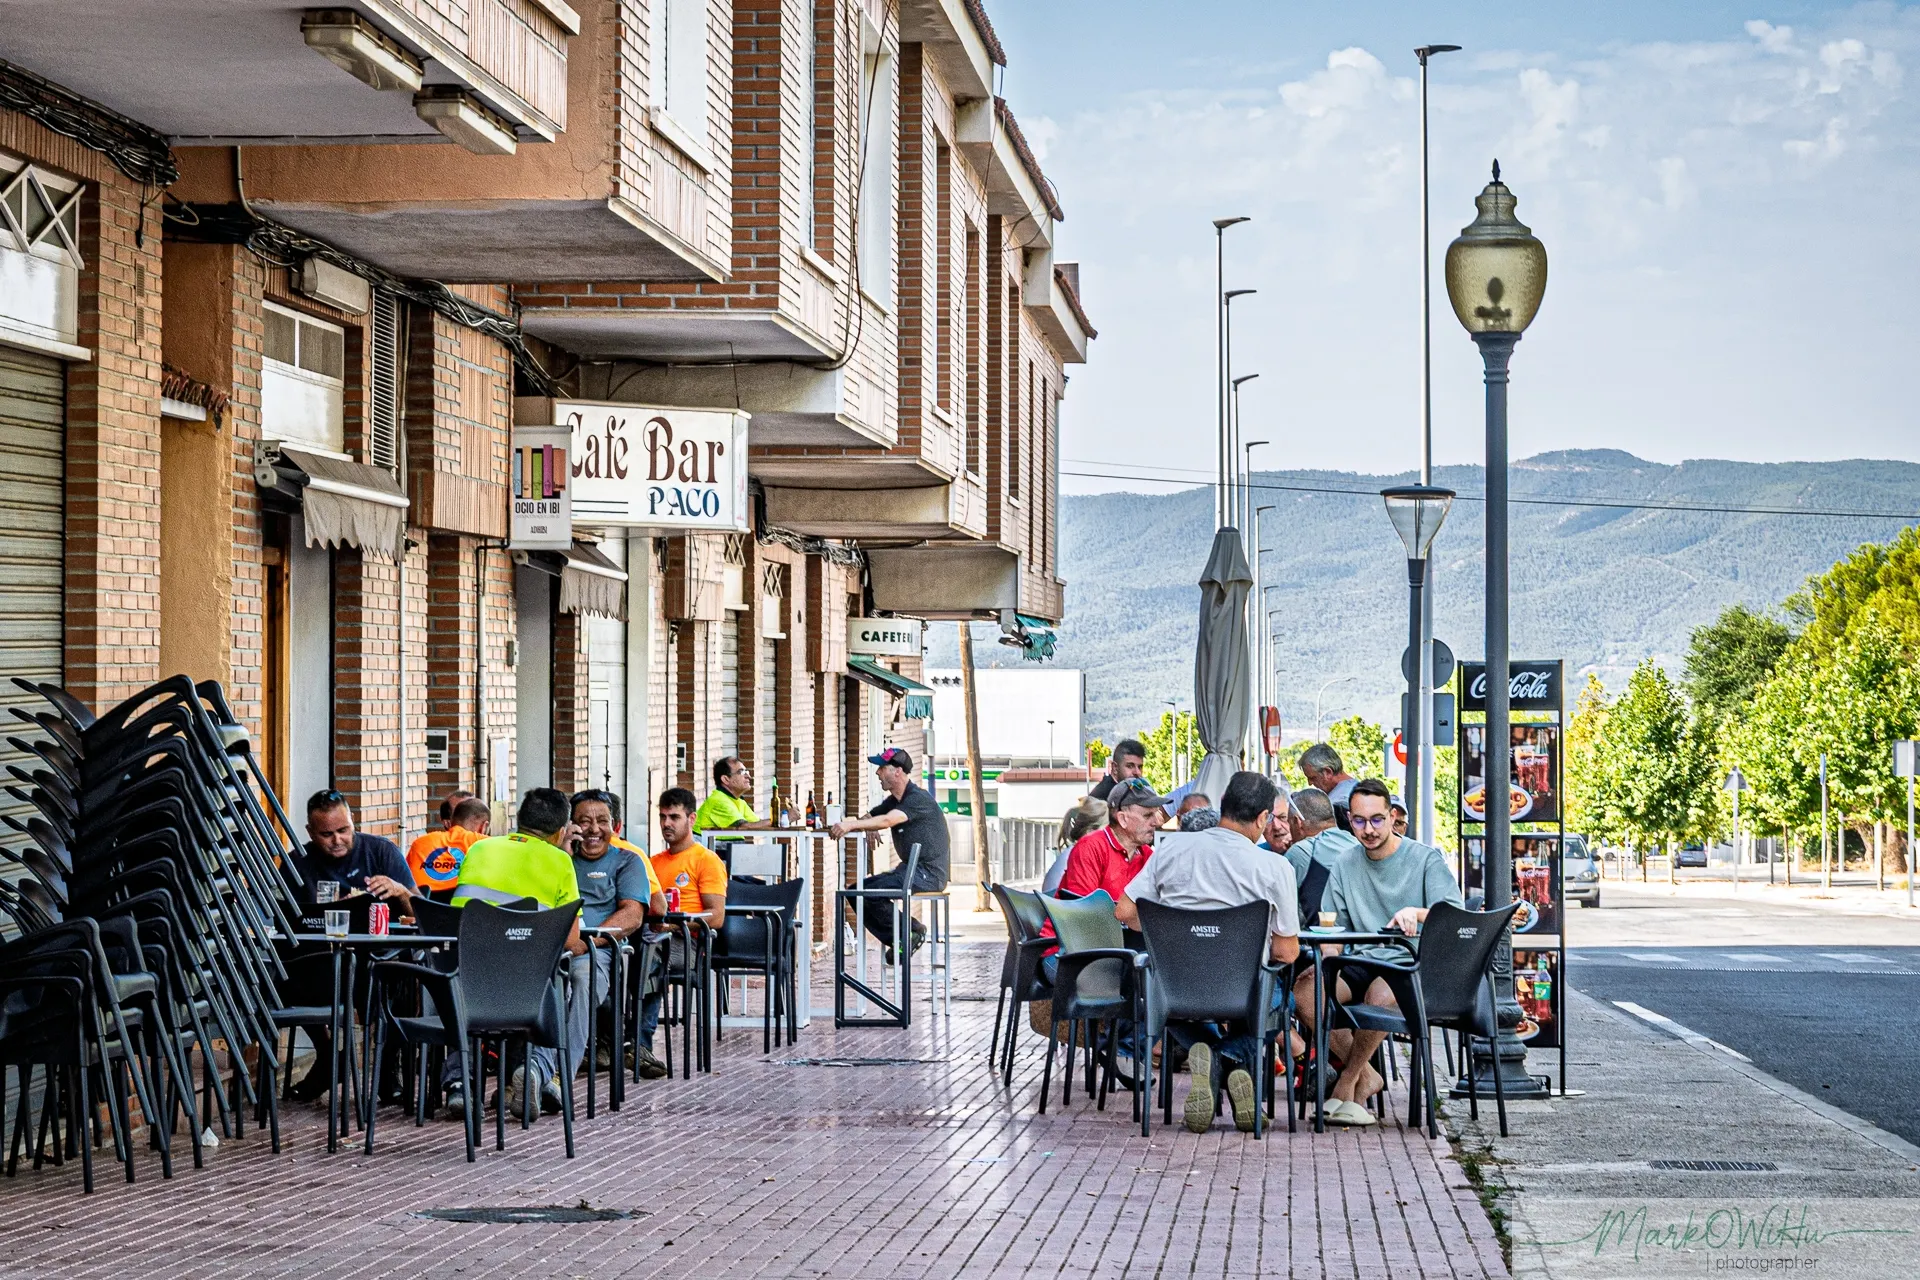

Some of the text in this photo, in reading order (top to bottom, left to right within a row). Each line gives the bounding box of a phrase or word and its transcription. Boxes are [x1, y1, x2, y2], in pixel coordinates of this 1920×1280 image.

[567, 412, 725, 484] Café Bar
[515, 502, 560, 514] OCIO EN IBI
[646, 486, 720, 518] PACO
[1190, 925, 1221, 933] AMSTEL
